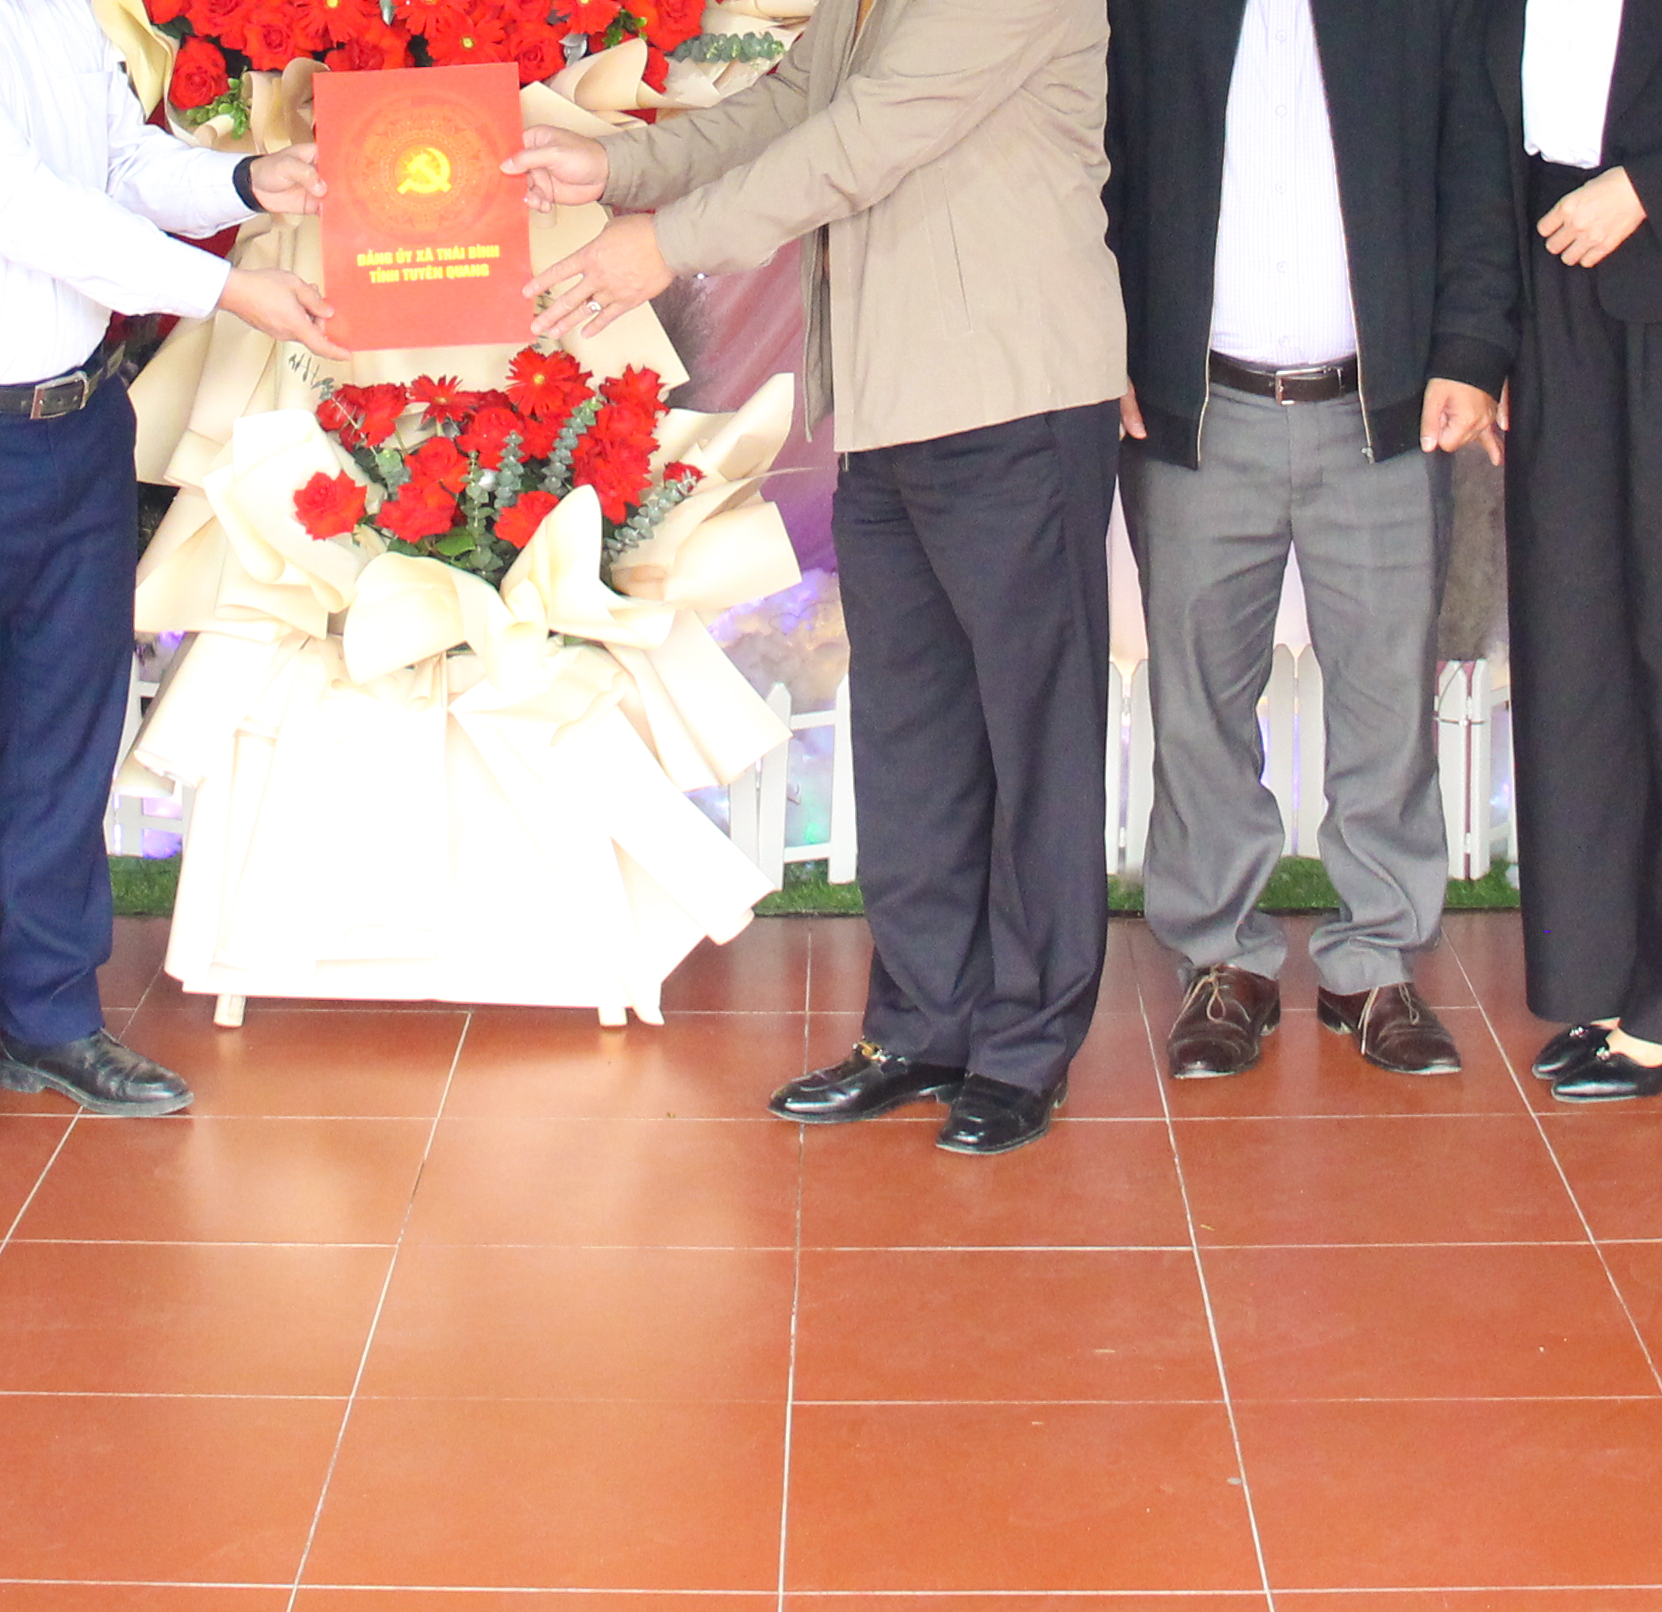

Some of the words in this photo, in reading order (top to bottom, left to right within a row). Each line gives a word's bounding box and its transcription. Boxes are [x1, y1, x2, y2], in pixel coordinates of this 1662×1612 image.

[356, 249, 394, 267] ĐẢNG
[395, 247, 413, 264] ỦY
[415, 247, 434, 263] XÃ
[436, 245, 466, 261] THÁI
[467, 243, 501, 259] BÌNH
[402, 264, 444, 281] TUYÊN
[446, 263, 490, 279] QUANG
